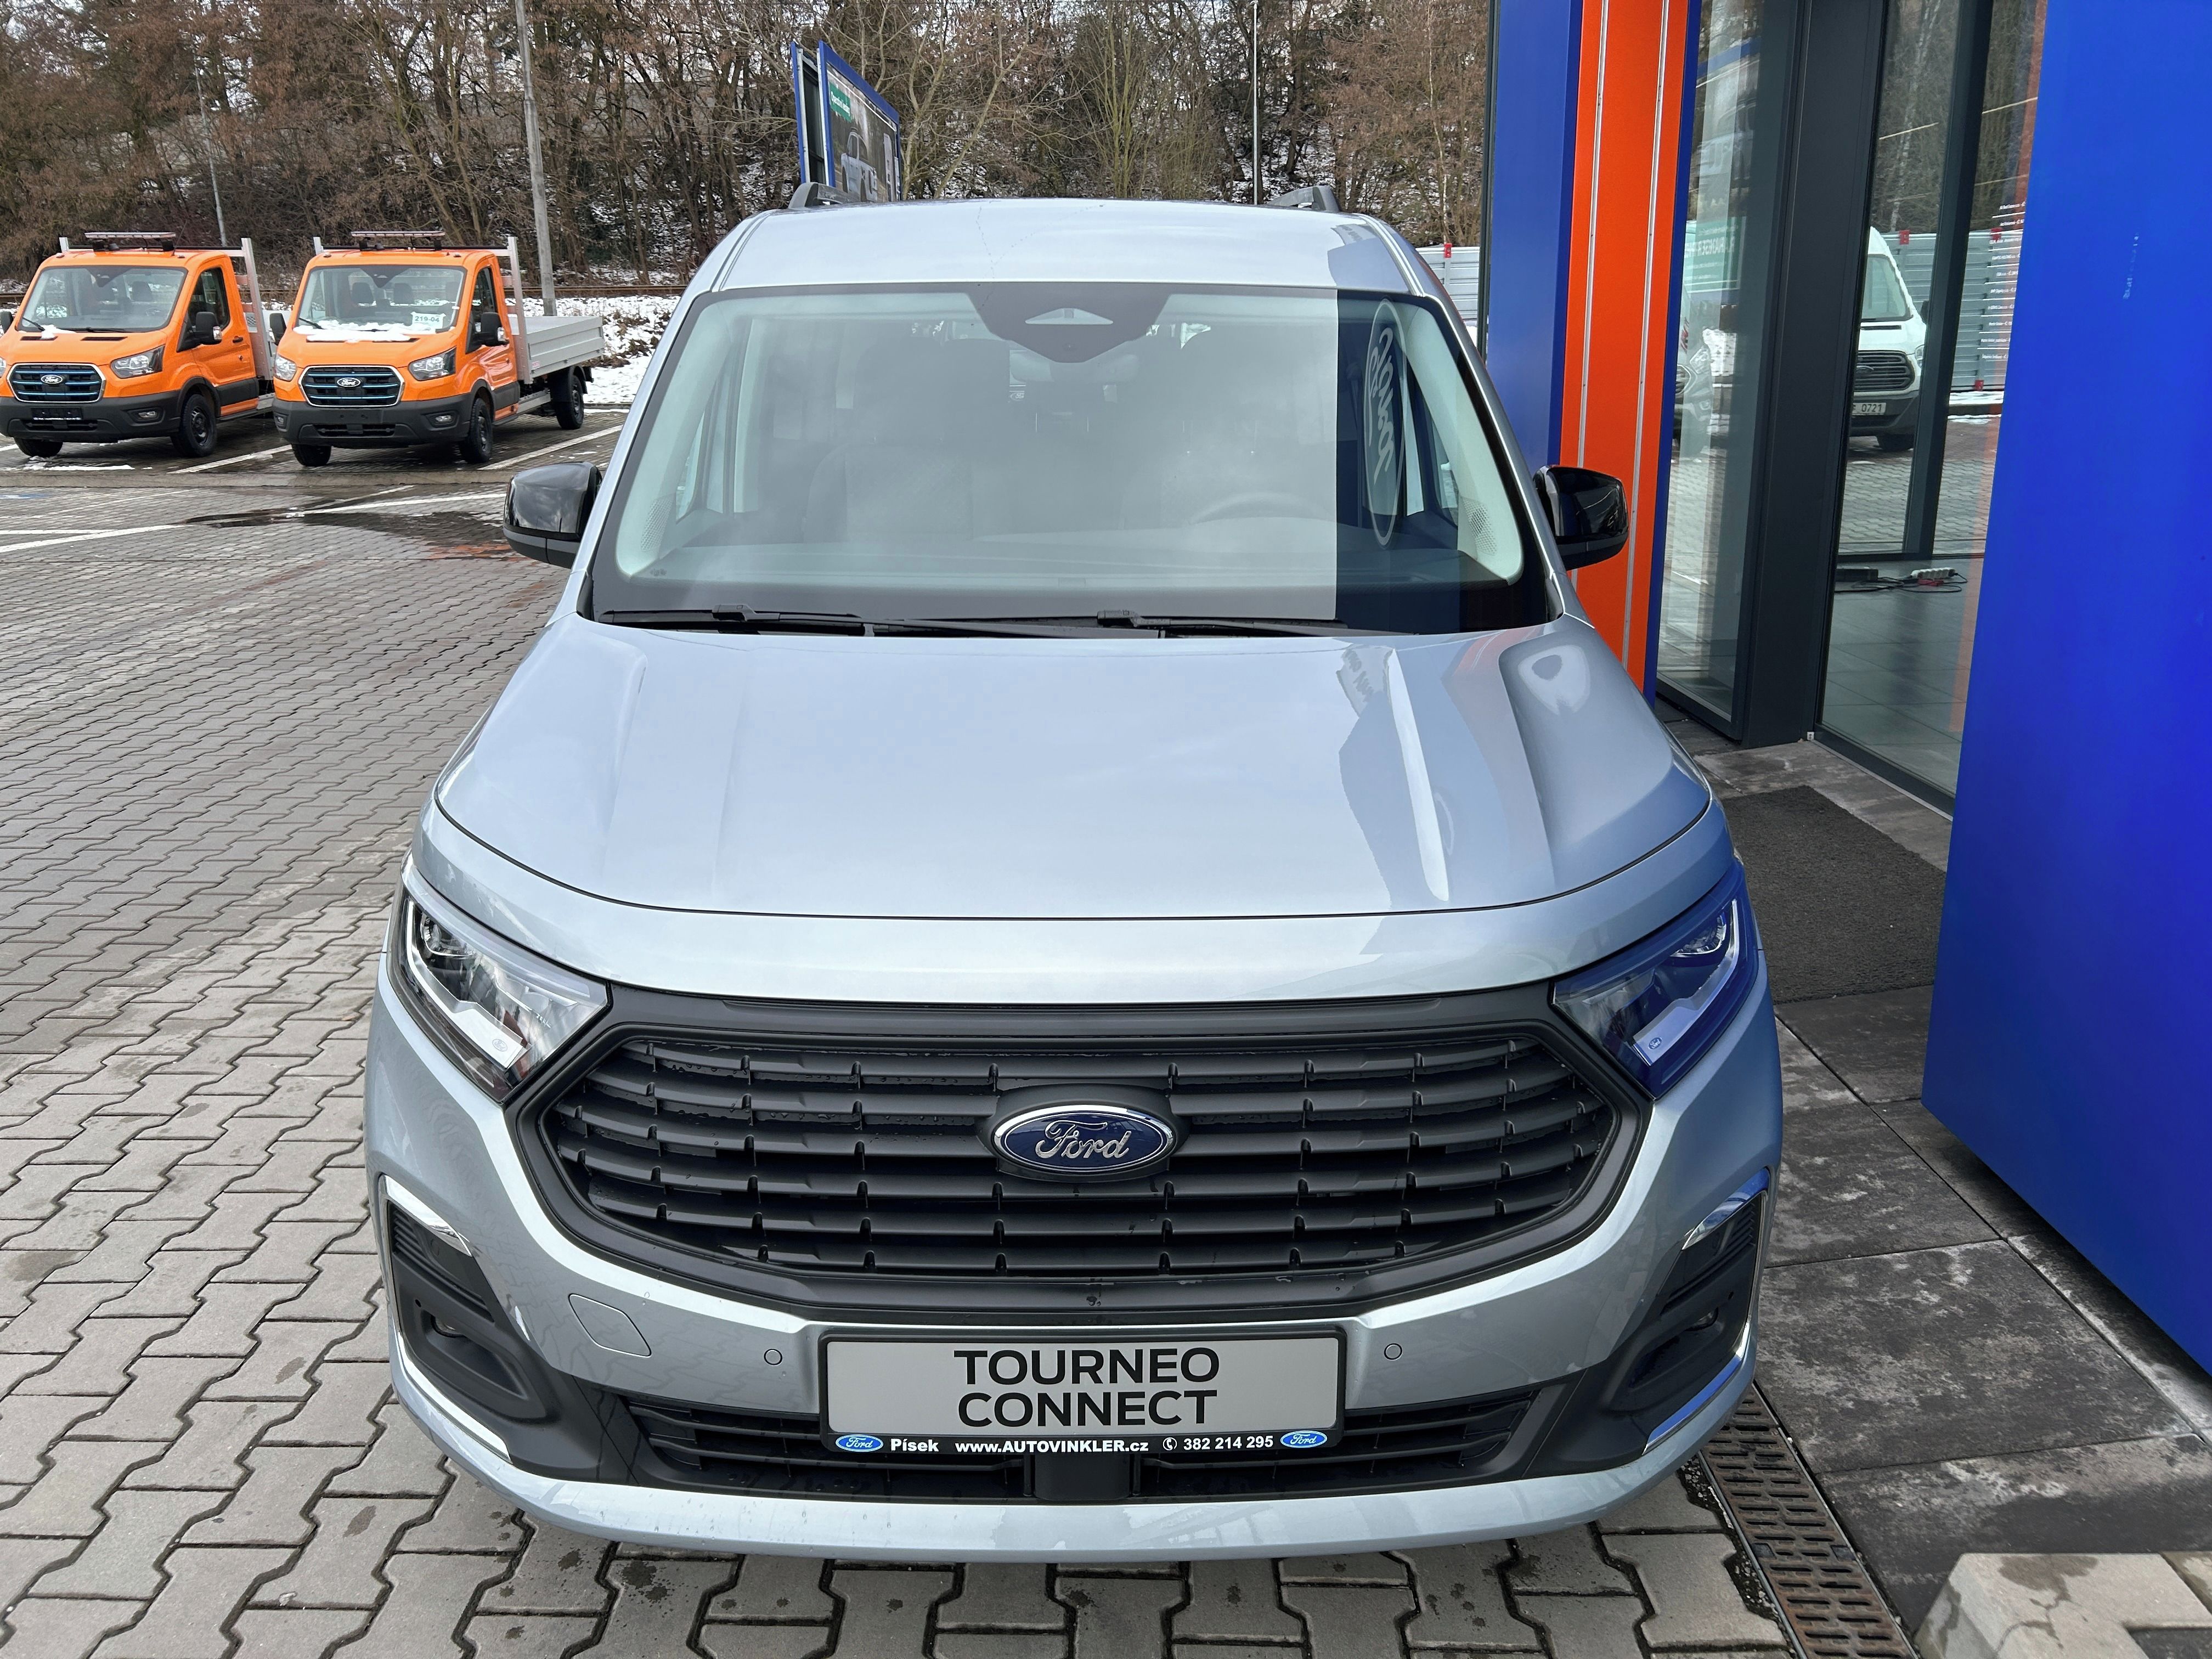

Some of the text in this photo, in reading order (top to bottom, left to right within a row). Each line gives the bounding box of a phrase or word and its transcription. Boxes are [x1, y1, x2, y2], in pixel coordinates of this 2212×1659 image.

[1861, 404, 1882, 413] 0721
[1035, 1120, 1132, 1159] Ford
[953, 1347, 1220, 1385] TOURNEO
[958, 1390, 1217, 1427] CONNECT
[845, 1434, 1317, 1453] Ford Písek www.AUTOVINKLER.cz 382 214 295 Ford
